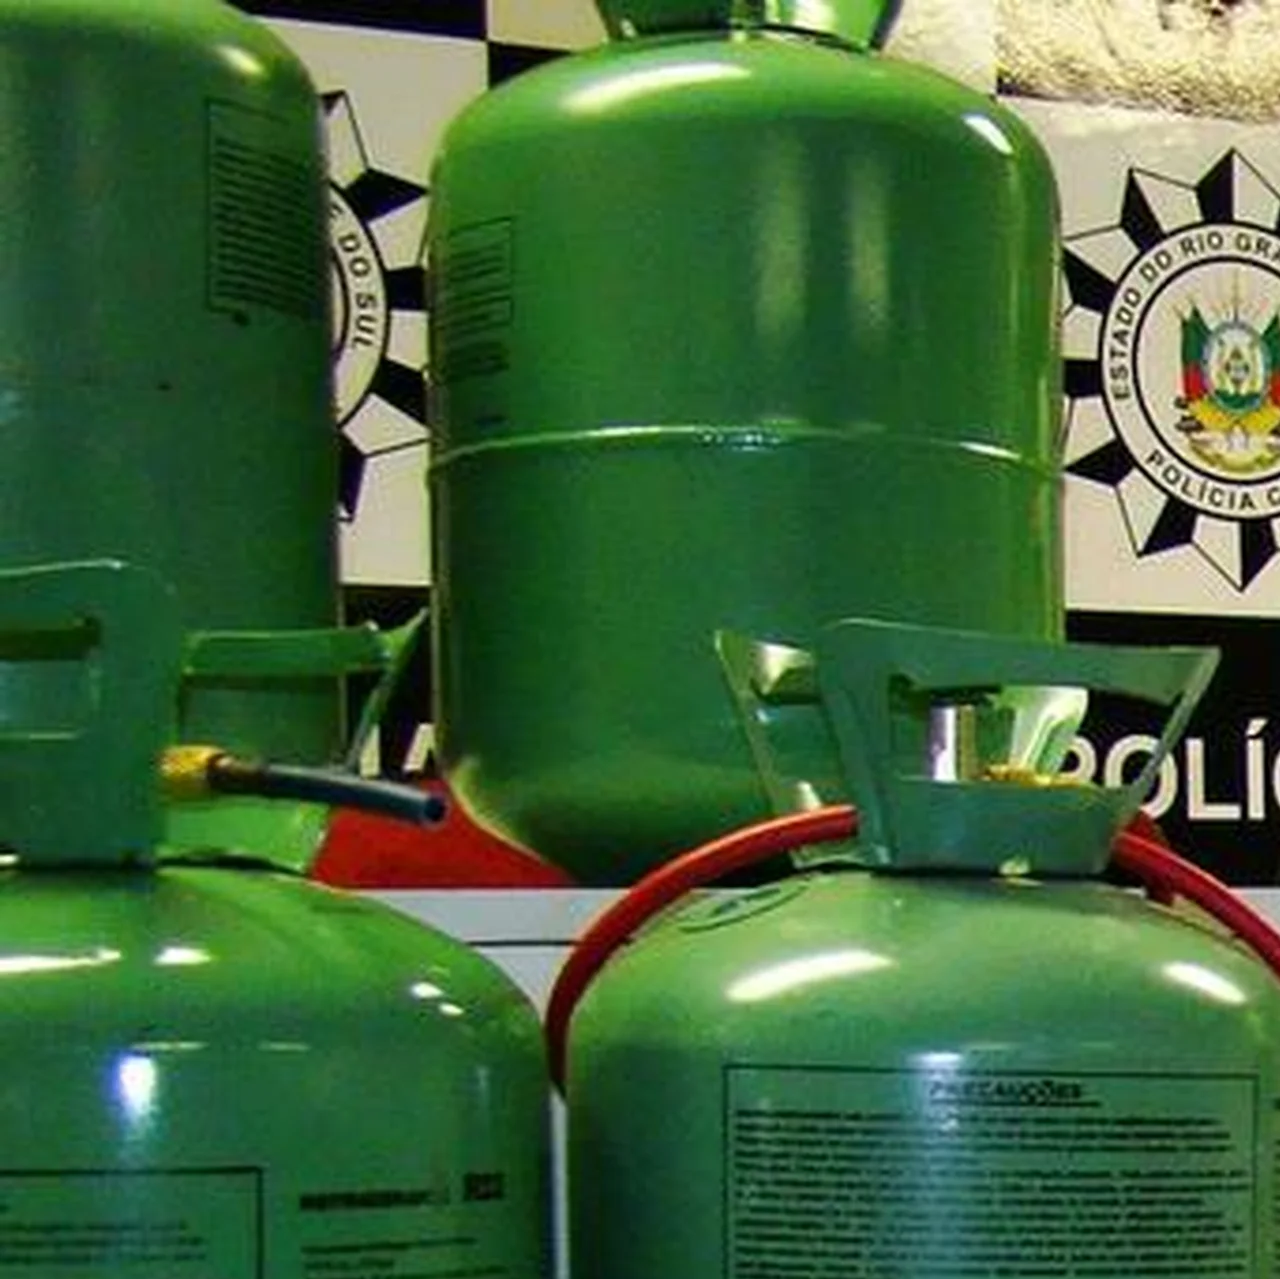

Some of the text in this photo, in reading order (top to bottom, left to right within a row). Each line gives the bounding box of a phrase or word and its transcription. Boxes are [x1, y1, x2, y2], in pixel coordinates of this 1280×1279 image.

[338, 234, 379, 349] DO SUL
[1109, 286, 1142, 400] ESTADO
[1138, 250, 1174, 284] DO
[1179, 230, 1224, 257] RIO
[1146, 449, 1257, 511] POLÍCIA
